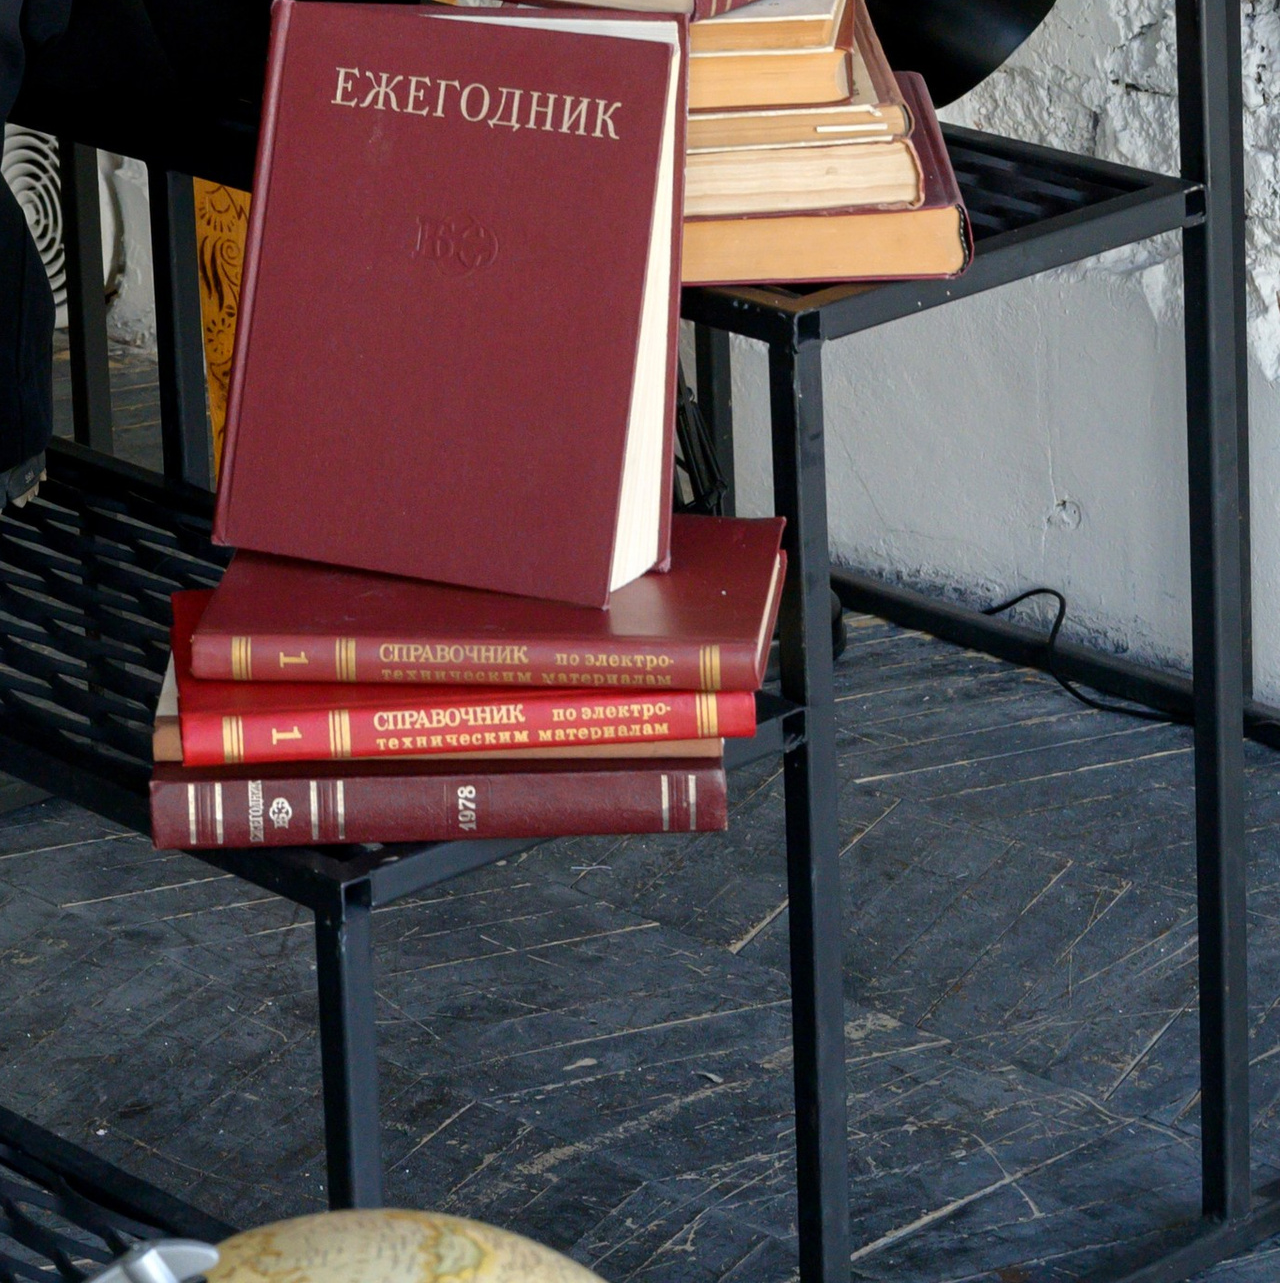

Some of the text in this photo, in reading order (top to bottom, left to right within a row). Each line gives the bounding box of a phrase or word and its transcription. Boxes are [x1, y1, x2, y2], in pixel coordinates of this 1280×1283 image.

[330, 67, 622, 140] ЕЖЕГОДНИК
[279, 651, 309, 669] 1
[379, 643, 674, 668] СПРАВОЧНИК по электро-
[381, 667, 672, 686] техническим материалам
[373, 701, 672, 731] СПРАВОЧНИК по электро-
[272, 726, 302, 745] 1
[376, 722, 669, 751] техническим материалам
[457, 785, 477, 831] 1978
